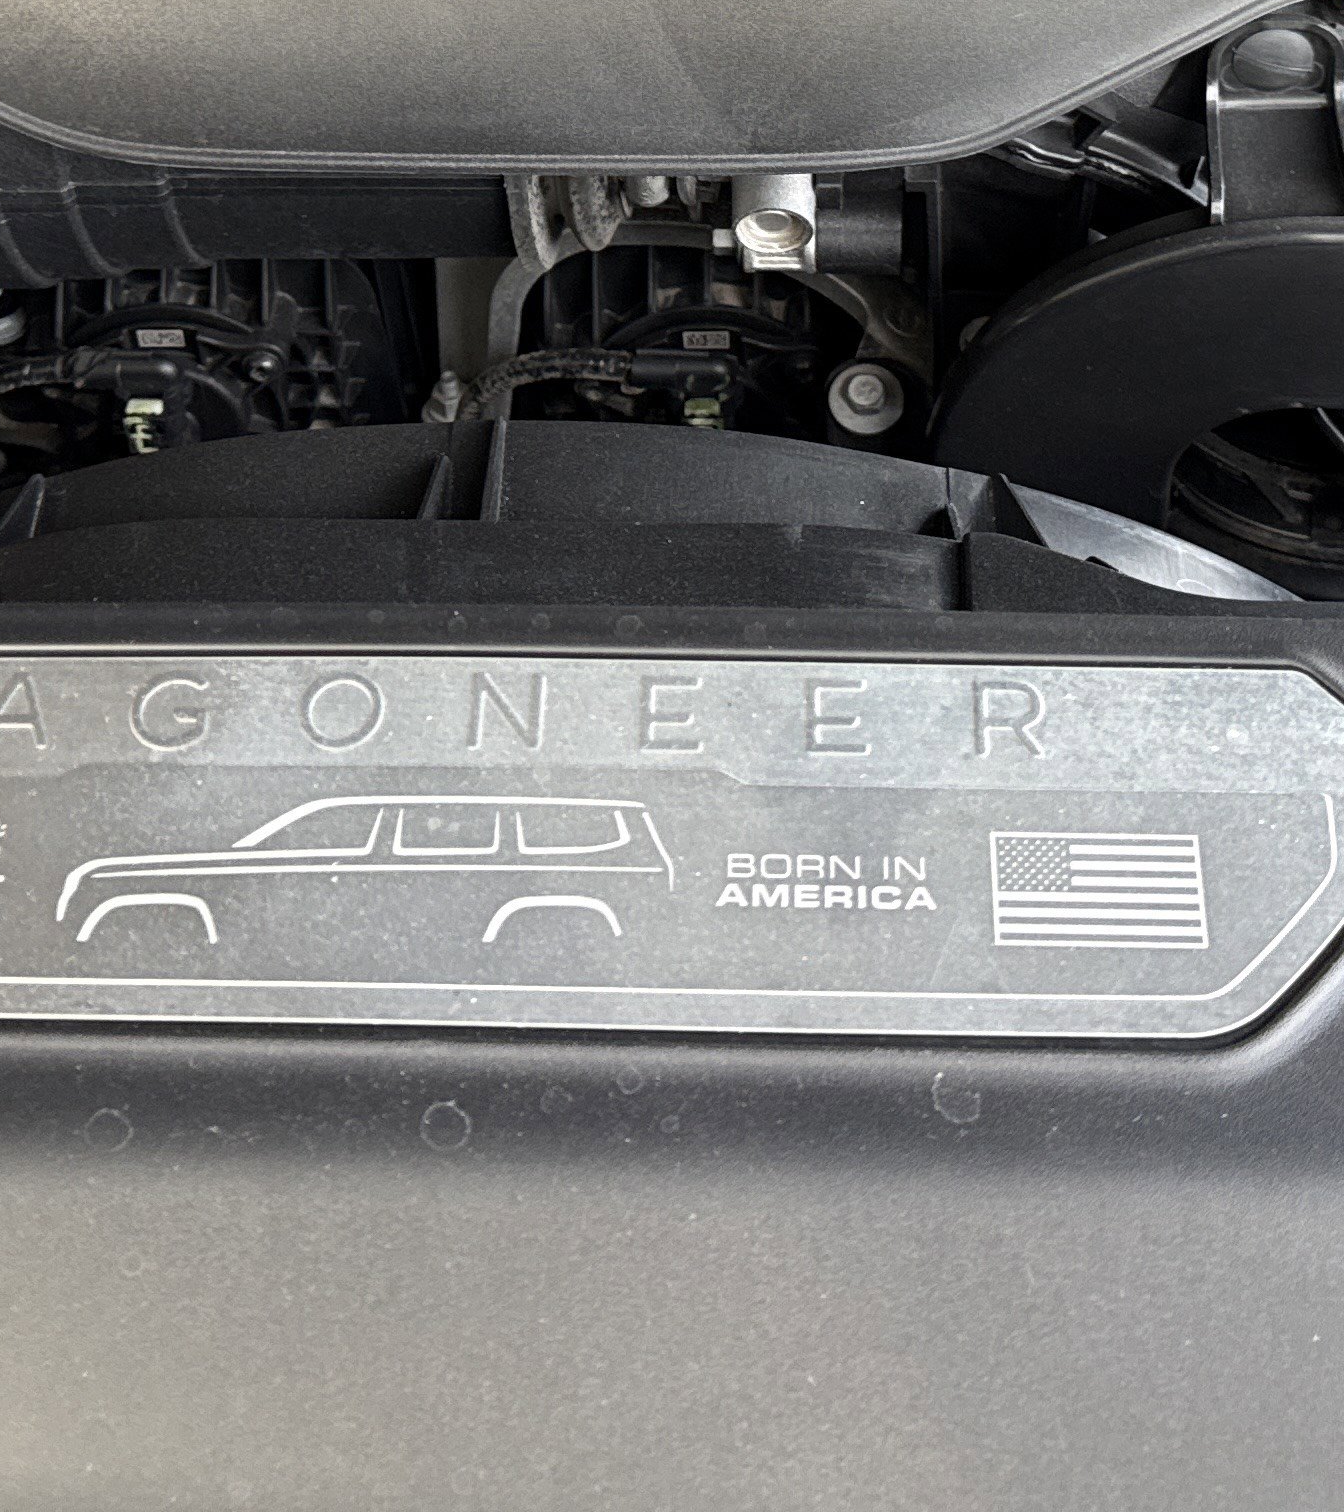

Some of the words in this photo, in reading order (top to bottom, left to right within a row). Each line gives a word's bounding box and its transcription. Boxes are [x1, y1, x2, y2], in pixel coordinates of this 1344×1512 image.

[726, 853, 861, 880] BORN
[883, 855, 927, 881] IN
[714, 883, 938, 911] AMERICA
